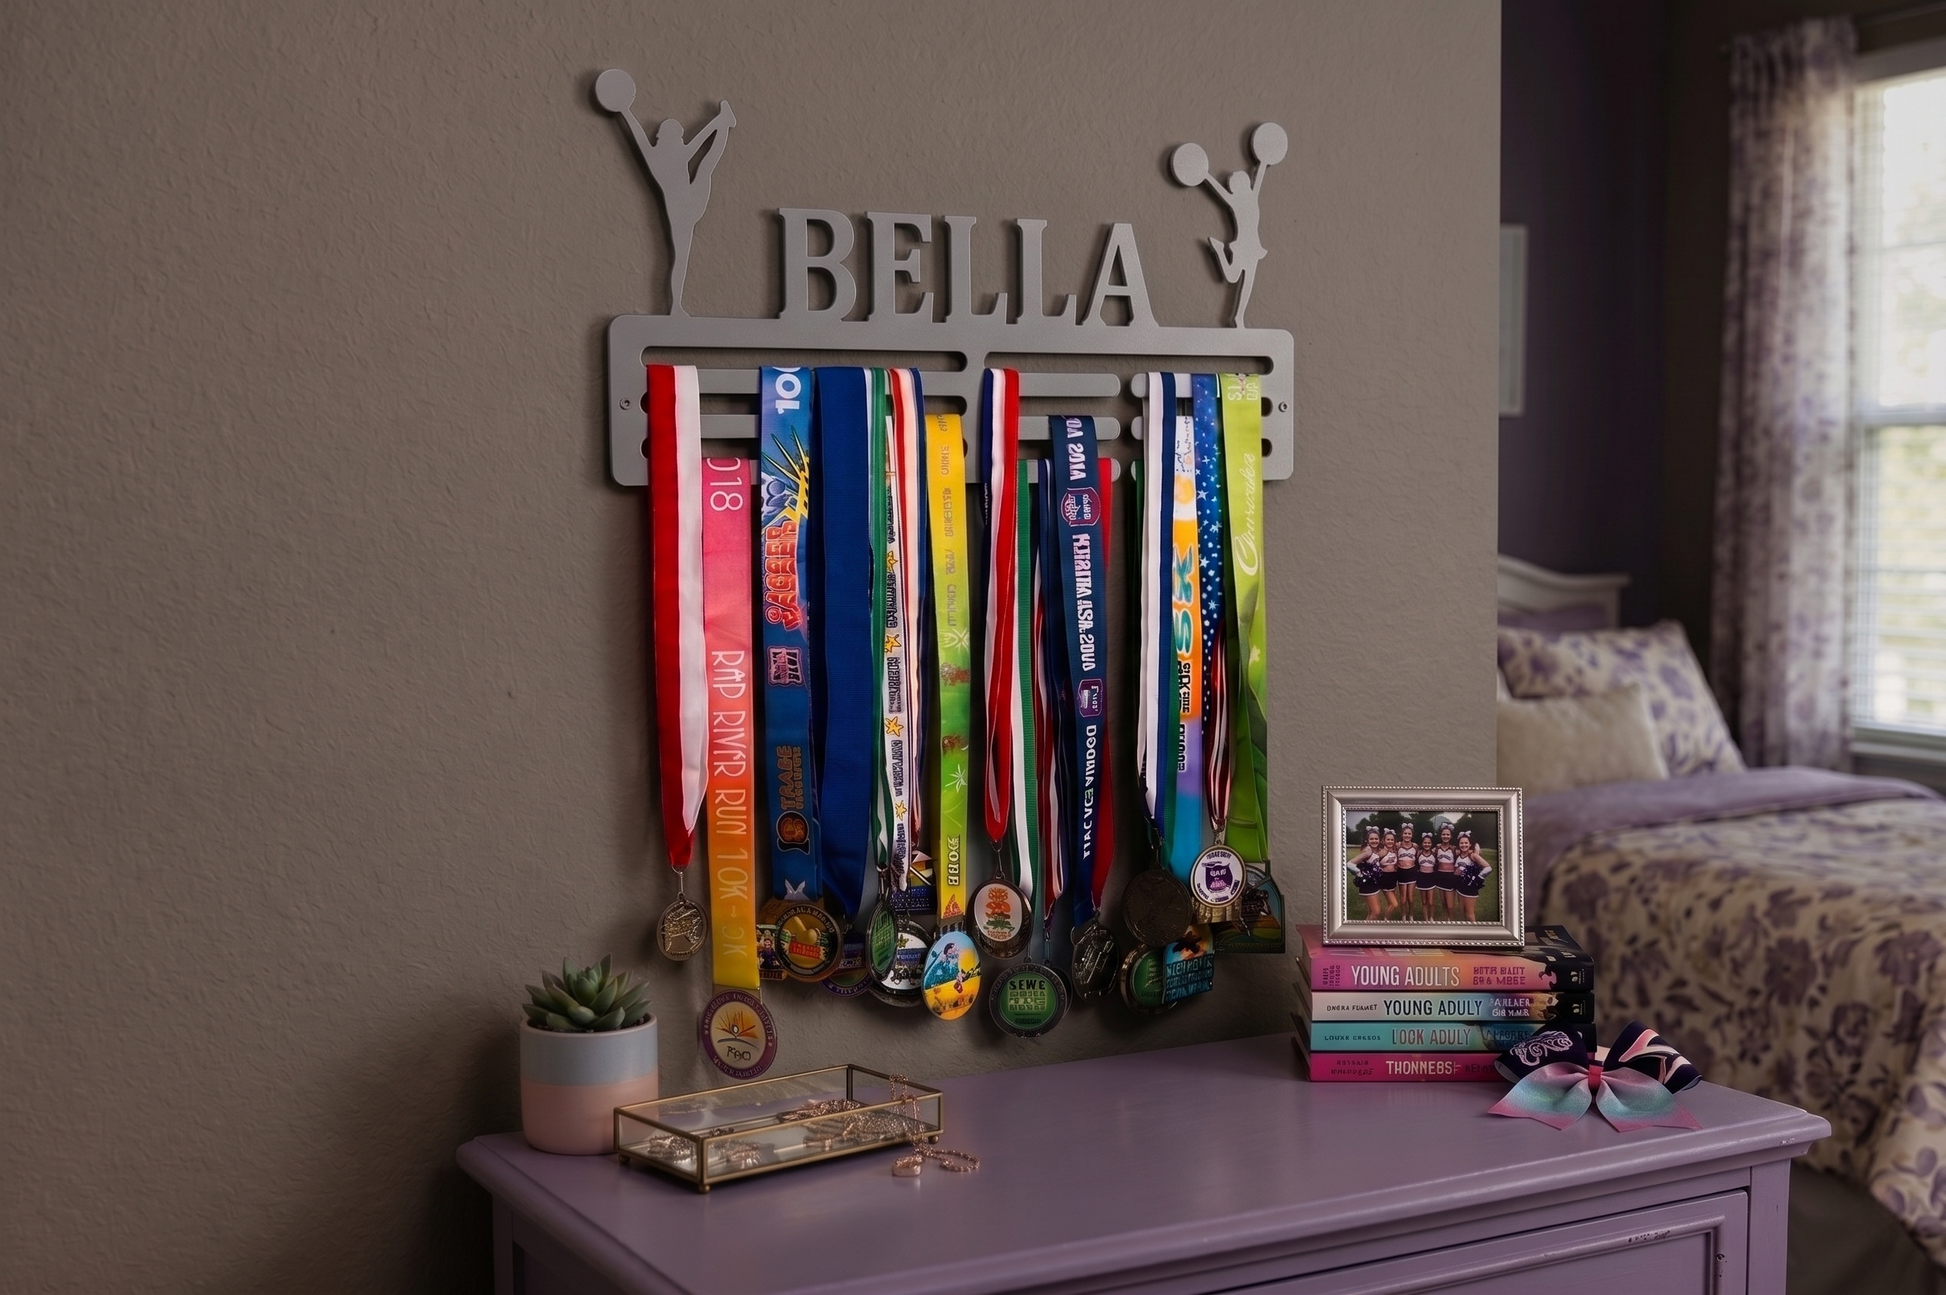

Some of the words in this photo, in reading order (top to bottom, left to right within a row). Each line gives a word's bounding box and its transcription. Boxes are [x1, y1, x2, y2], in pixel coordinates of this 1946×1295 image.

[777, 206, 1160, 328] BELLA
[774, 366, 802, 415] 10
[1351, 965, 1399, 987] YOUNG
[1405, 965, 1461, 988] ADULTS
[1383, 1000, 1433, 1016] YOUNG
[1438, 1000, 1484, 1016] ADULY
[1430, 1029, 1471, 1045] ADULY
